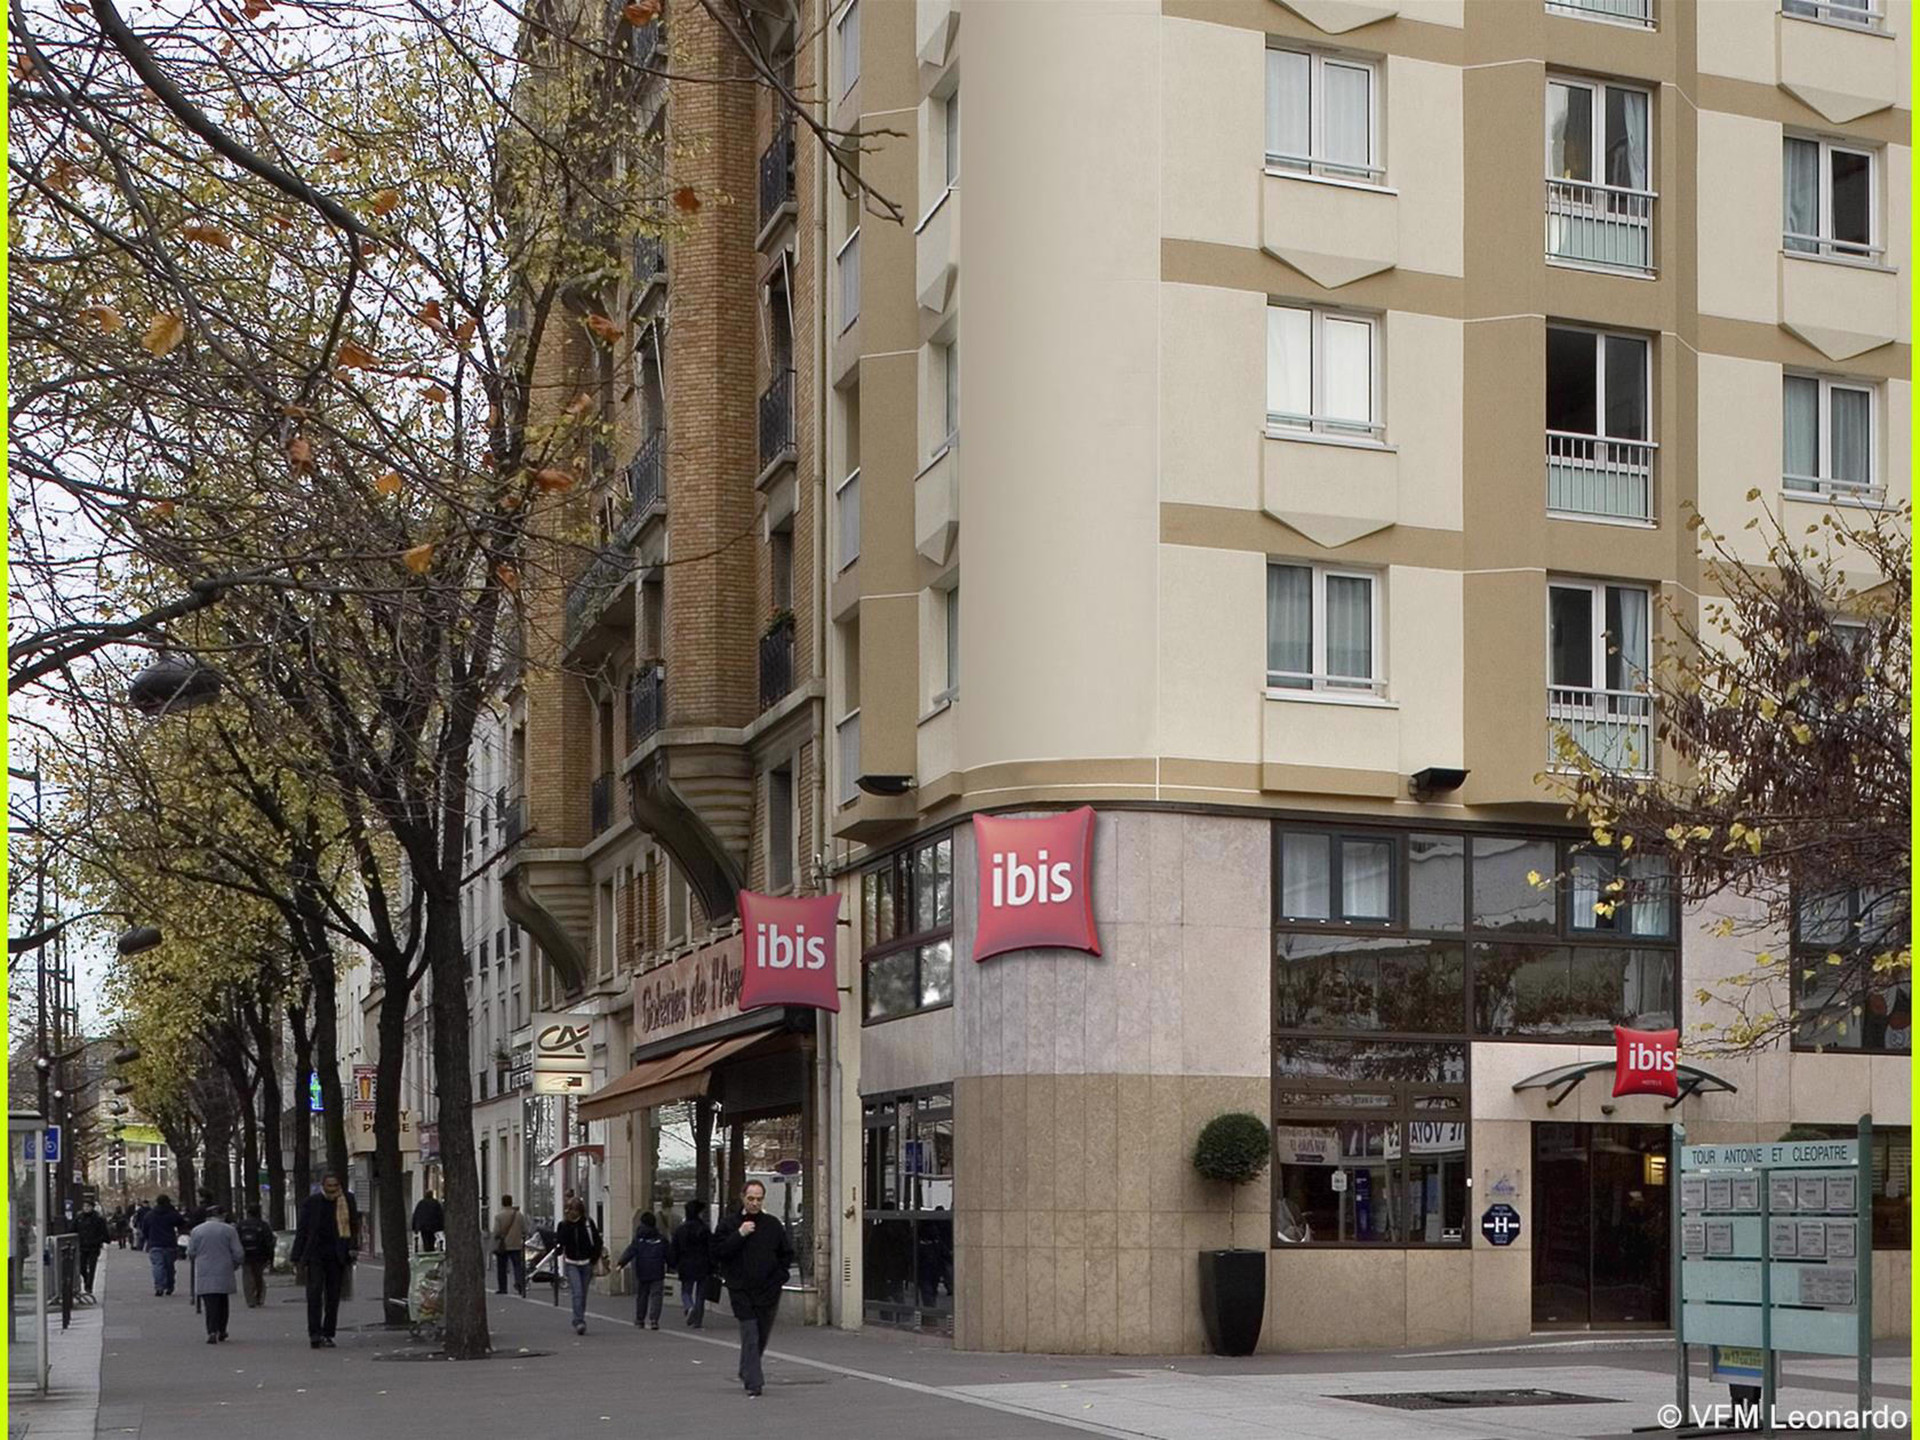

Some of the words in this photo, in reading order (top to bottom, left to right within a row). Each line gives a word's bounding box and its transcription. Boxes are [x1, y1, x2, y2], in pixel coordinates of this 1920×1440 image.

[993, 850, 1073, 907] ibis
[757, 923, 826, 969] ibis
[691, 964, 707, 1017] de
[537, 1024, 590, 1053] CA
[1629, 1043, 1675, 1071] ibis
[1691, 1150, 1716, 1165] TOUR
[1724, 1148, 1763, 1164] ANTOINE
[1771, 1147, 1783, 1162] ET
[1792, 1145, 1848, 1162] CLEOPATRE
[1495, 1216, 1508, 1233] H
